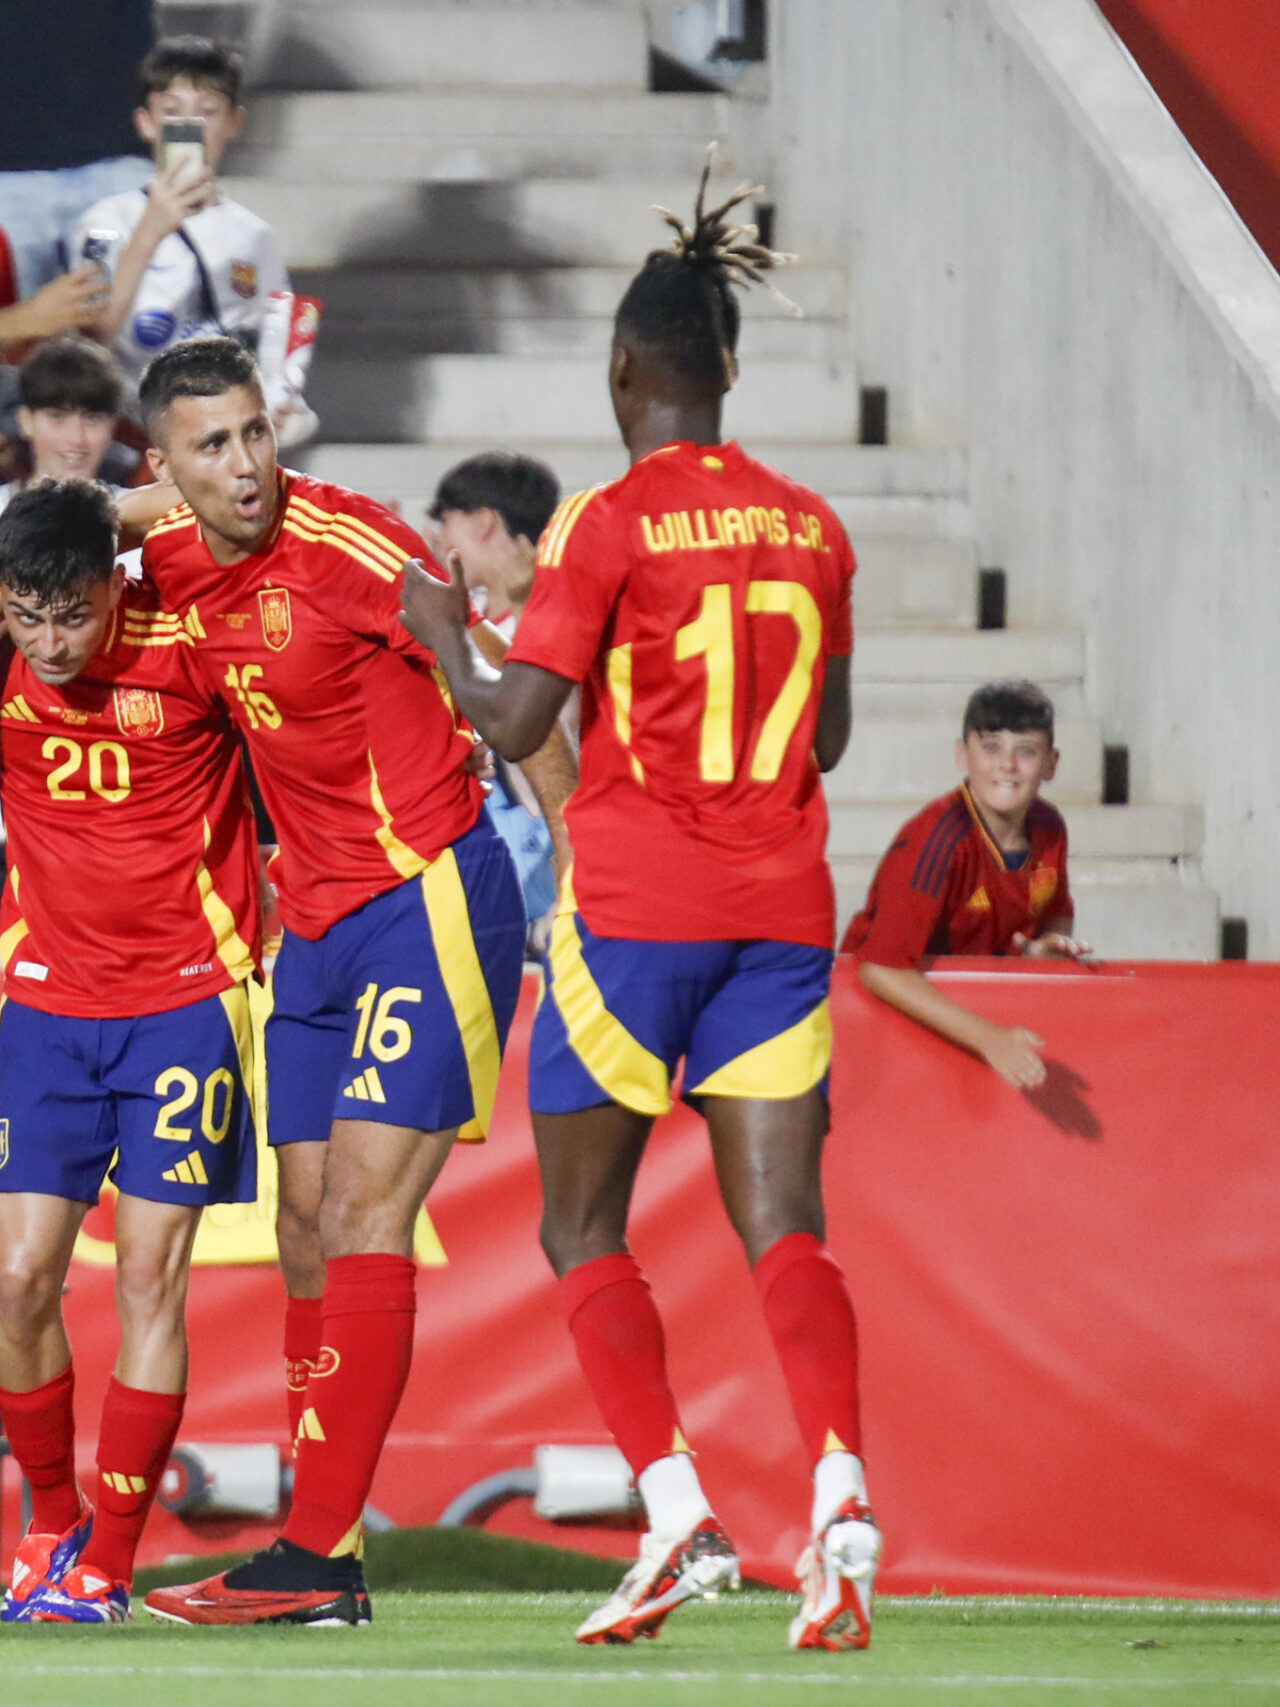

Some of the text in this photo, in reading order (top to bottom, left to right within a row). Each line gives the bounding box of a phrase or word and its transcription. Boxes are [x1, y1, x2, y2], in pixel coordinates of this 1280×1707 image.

[641, 506, 830, 553] WILLIAMS JR.
[224, 664, 283, 729] 16
[675, 581, 822, 783] 17
[42, 736, 131, 803] 20
[352, 982, 422, 1063] 16
[153, 1065, 235, 1144] 20
